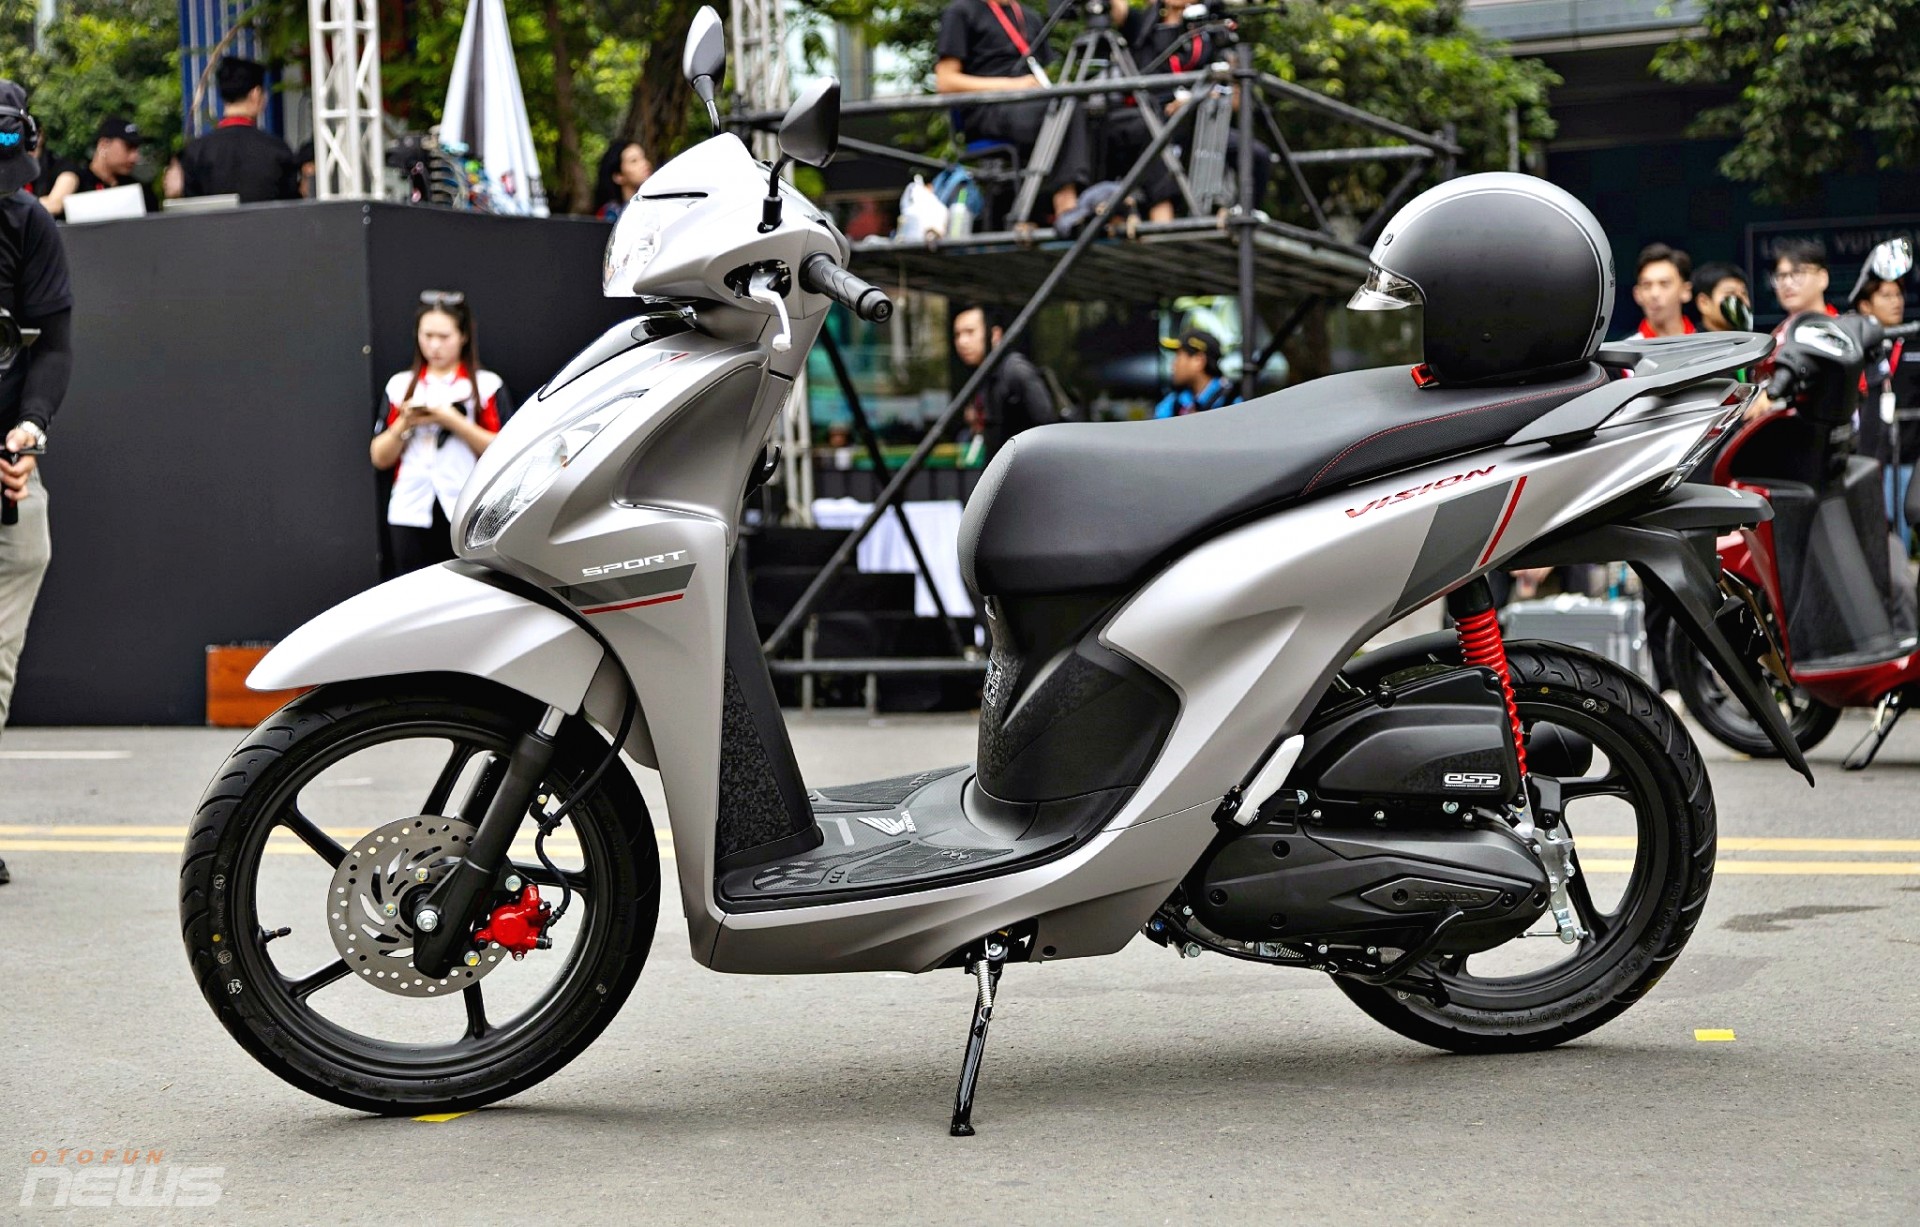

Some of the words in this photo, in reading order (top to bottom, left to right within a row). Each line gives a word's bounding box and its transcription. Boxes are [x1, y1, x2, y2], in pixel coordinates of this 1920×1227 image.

[1346, 465, 1497, 518] VISION
[582, 550, 687, 577] SPORT
[1415, 890, 1484, 902] HONDA
